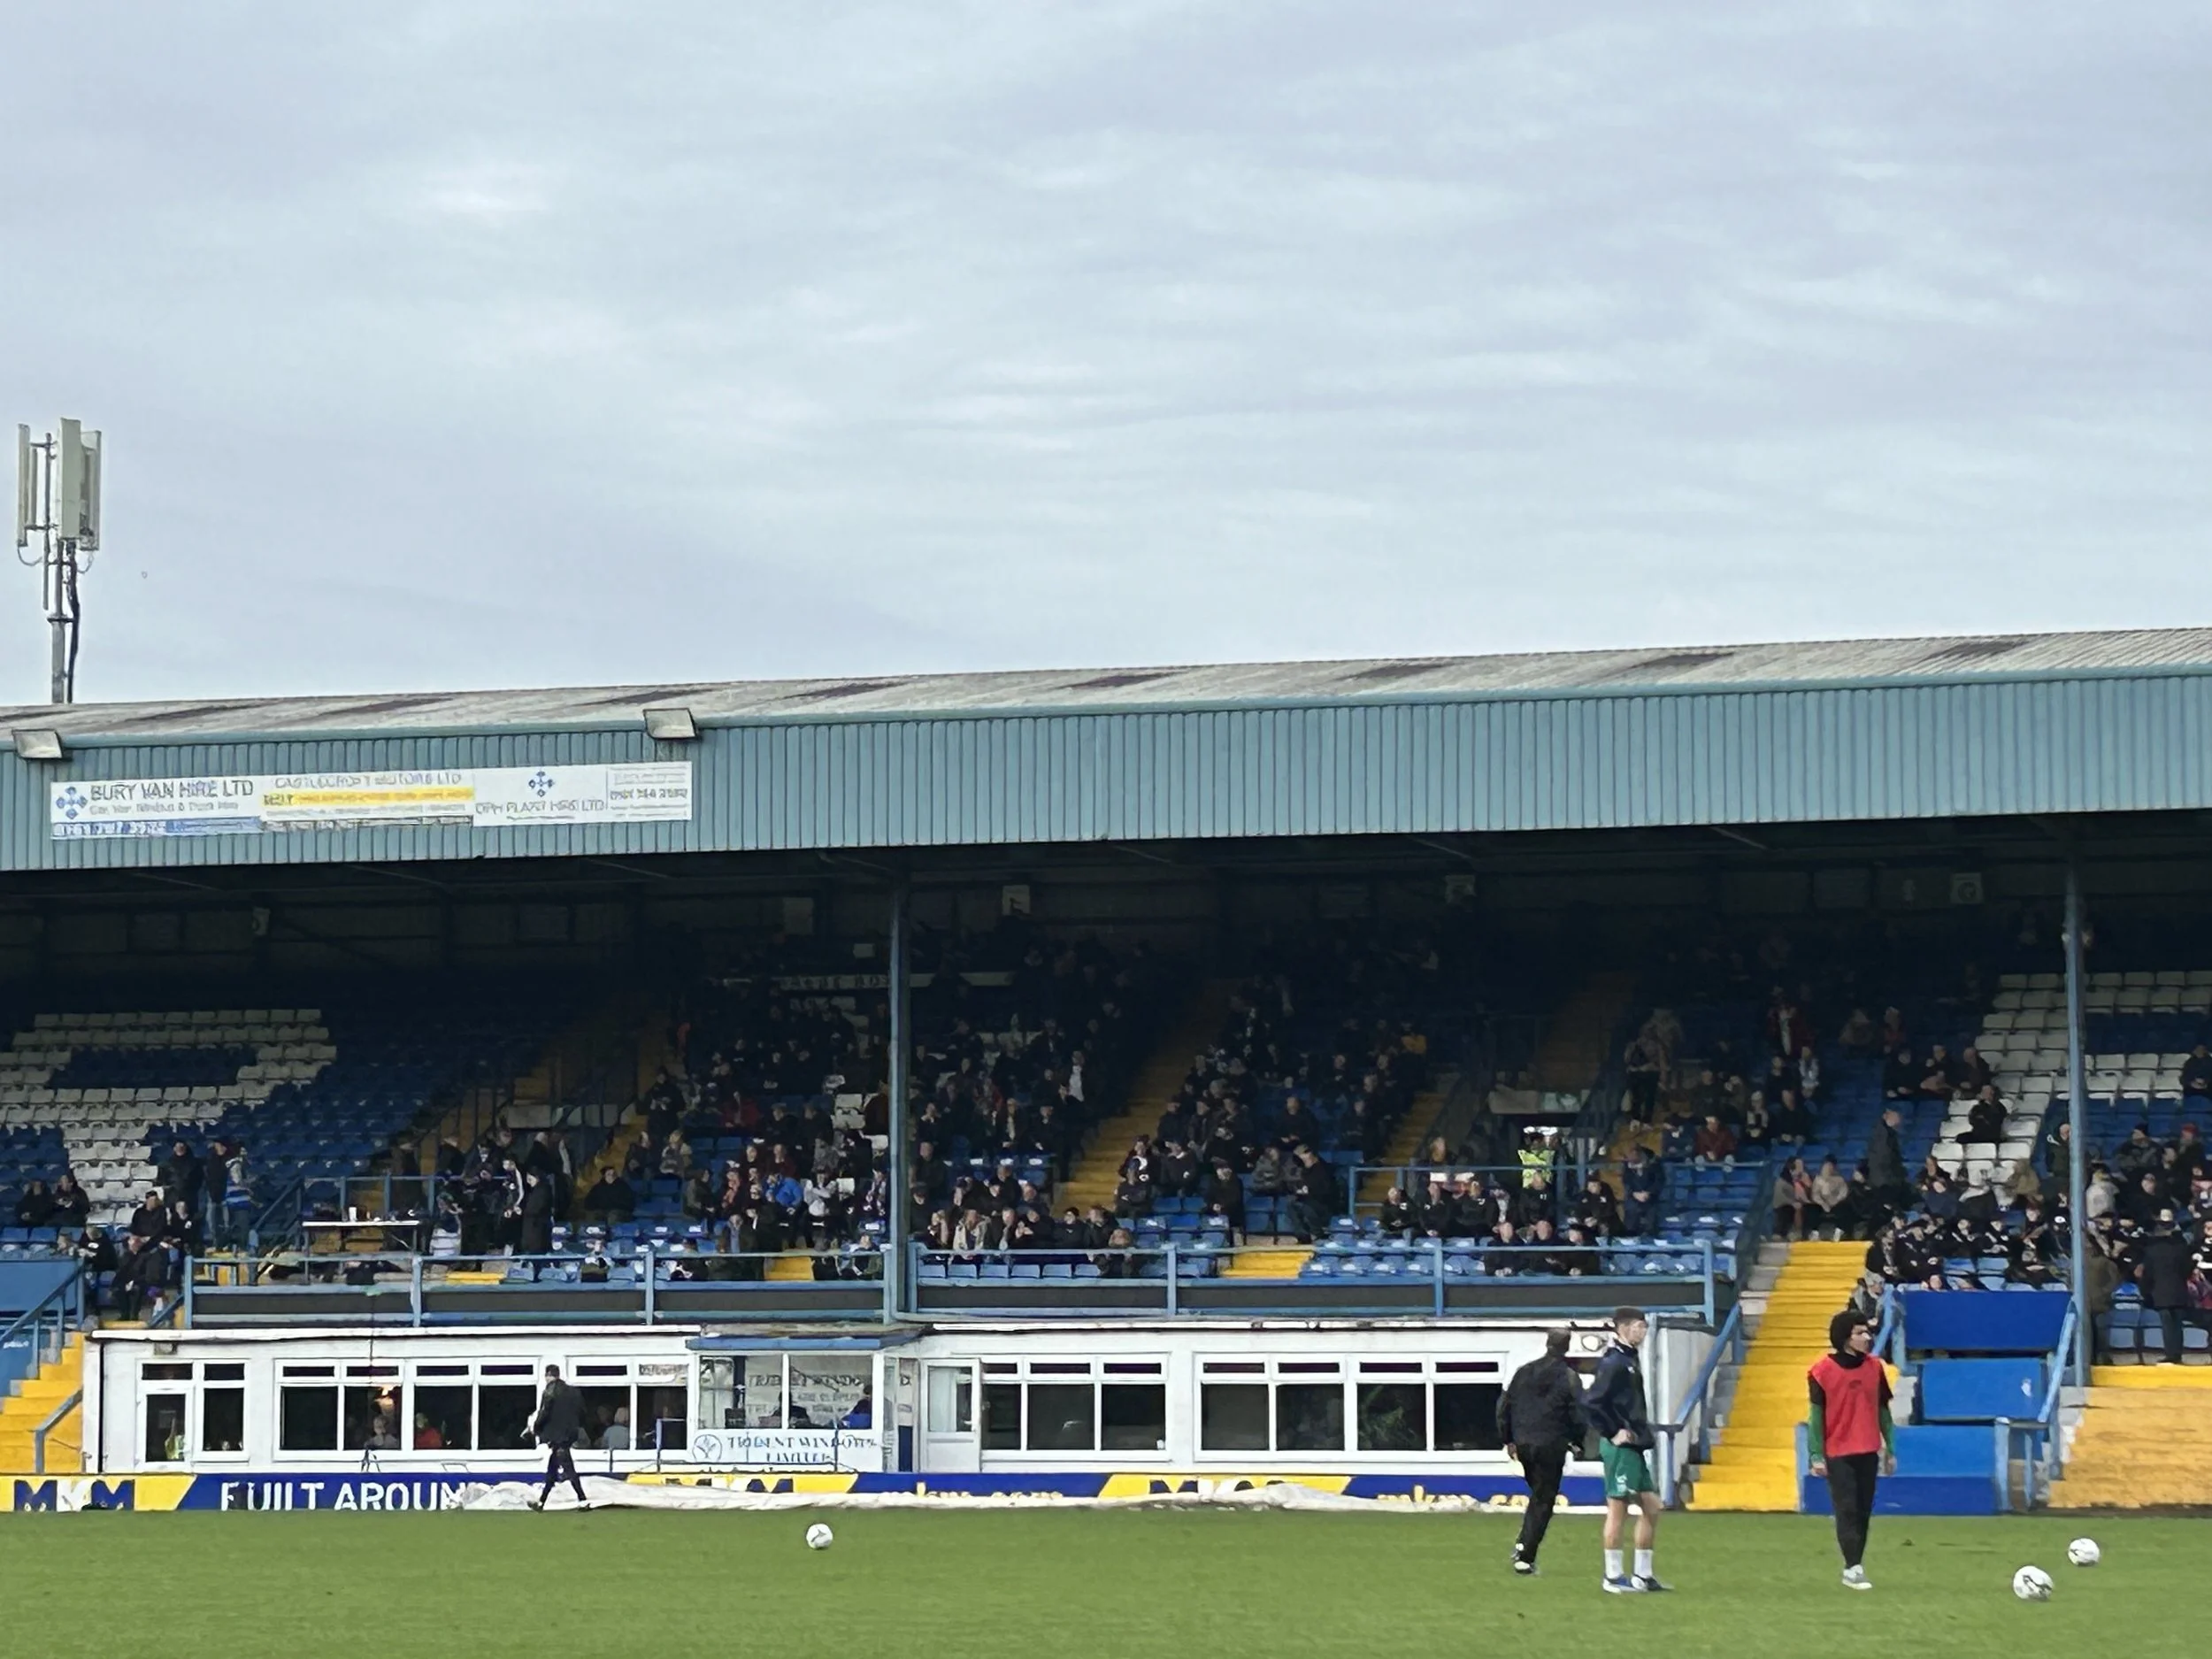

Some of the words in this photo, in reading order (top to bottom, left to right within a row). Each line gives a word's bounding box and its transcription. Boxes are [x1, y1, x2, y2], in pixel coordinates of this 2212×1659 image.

[89, 783, 137, 801] BURY
[141, 781, 174, 800] VAN
[180, 780, 219, 799] HIRE
[222, 779, 254, 797] LTD
[581, 799, 605, 811] LTD
[334, 1481, 468, 1511] AROUN
